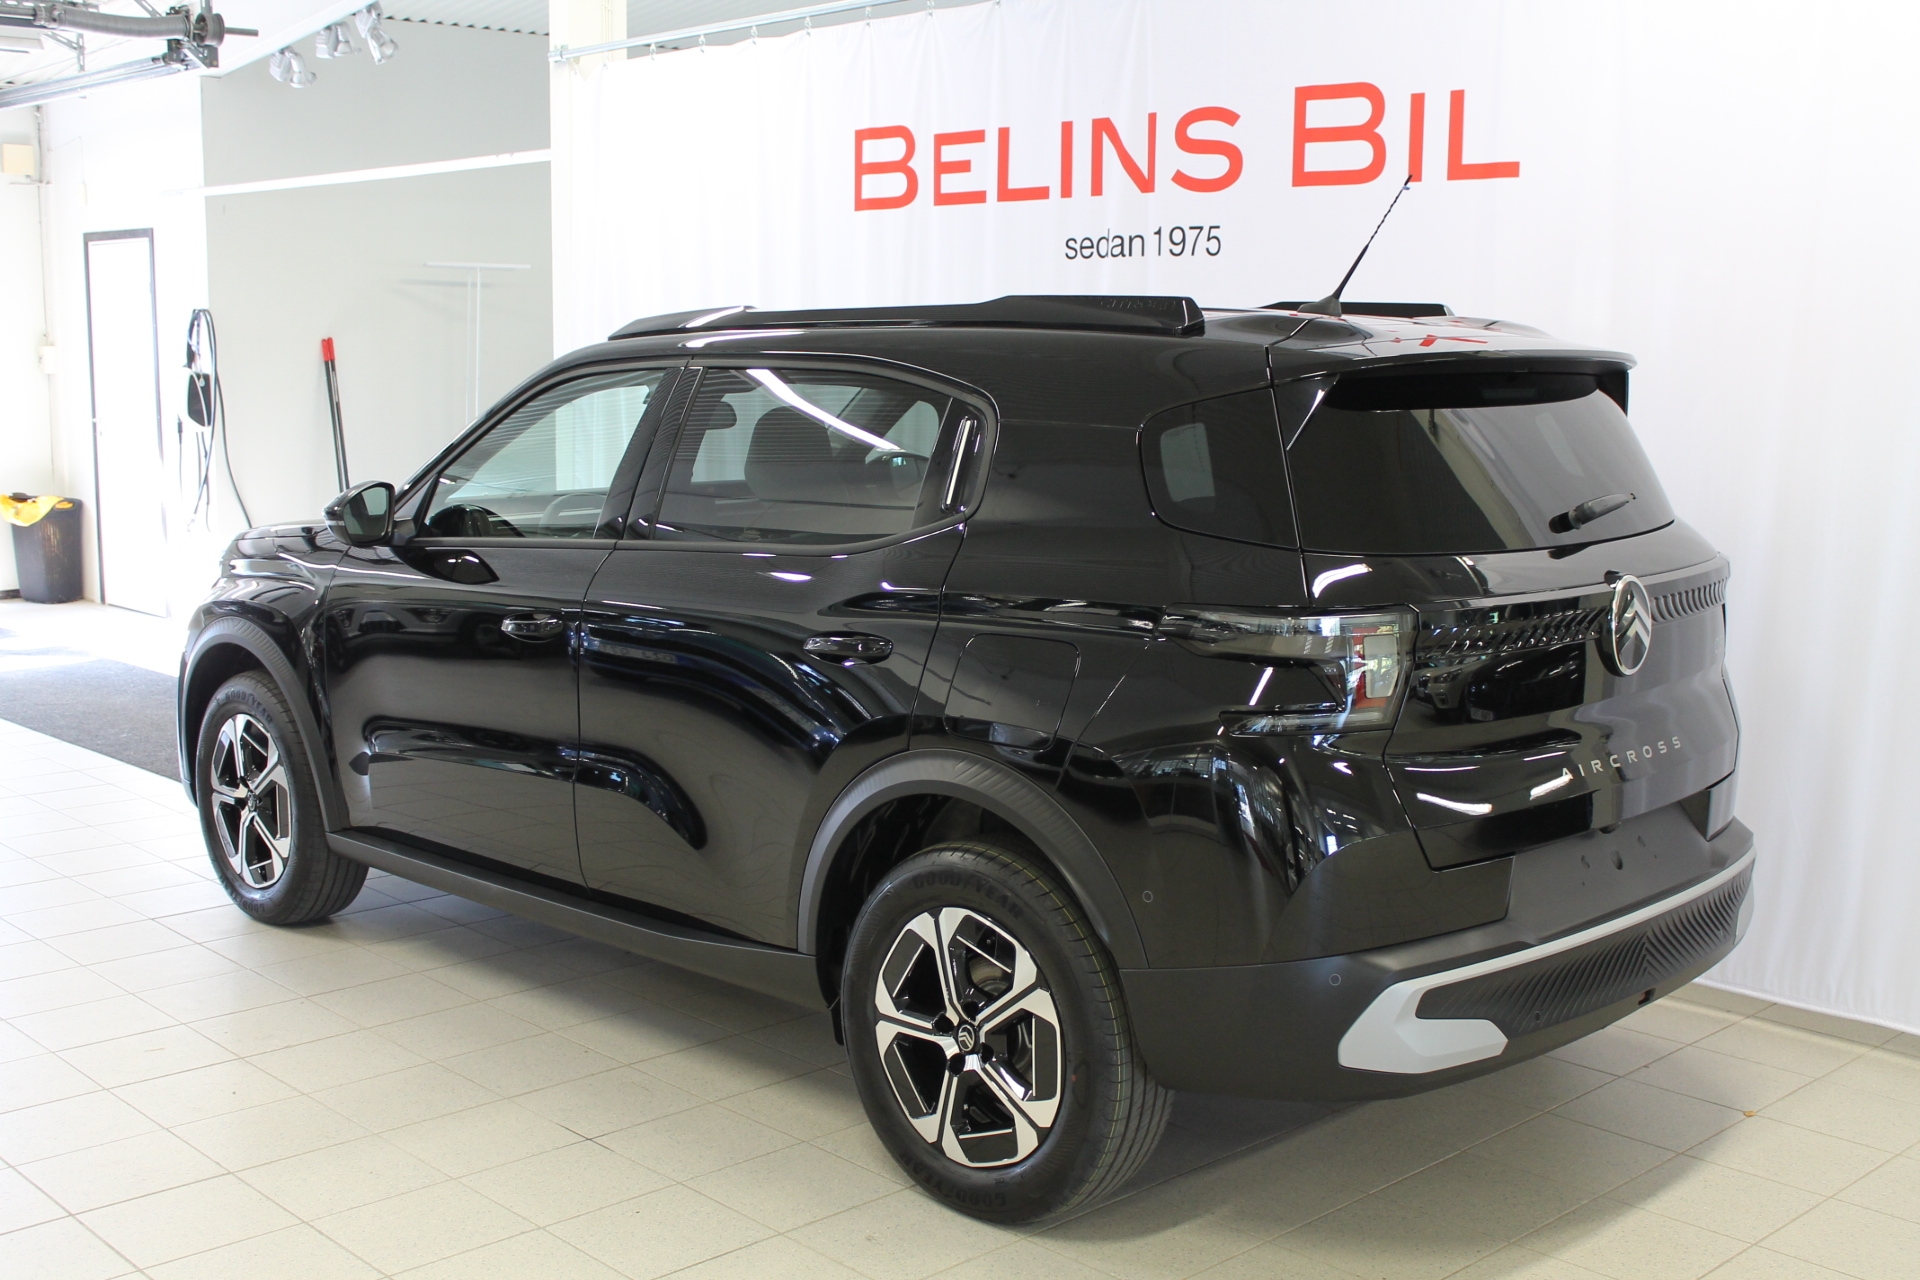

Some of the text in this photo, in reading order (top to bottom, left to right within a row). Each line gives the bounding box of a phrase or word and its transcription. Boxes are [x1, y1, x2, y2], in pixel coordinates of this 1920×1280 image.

[854, 81, 1520, 211] BELINS BIL
[1065, 225, 1222, 259] sedan 1975
[225, 690, 273, 724] GOODYEAR
[1562, 736, 1681, 779] AIRCROSS
[912, 870, 1023, 919] GOODYEAR
